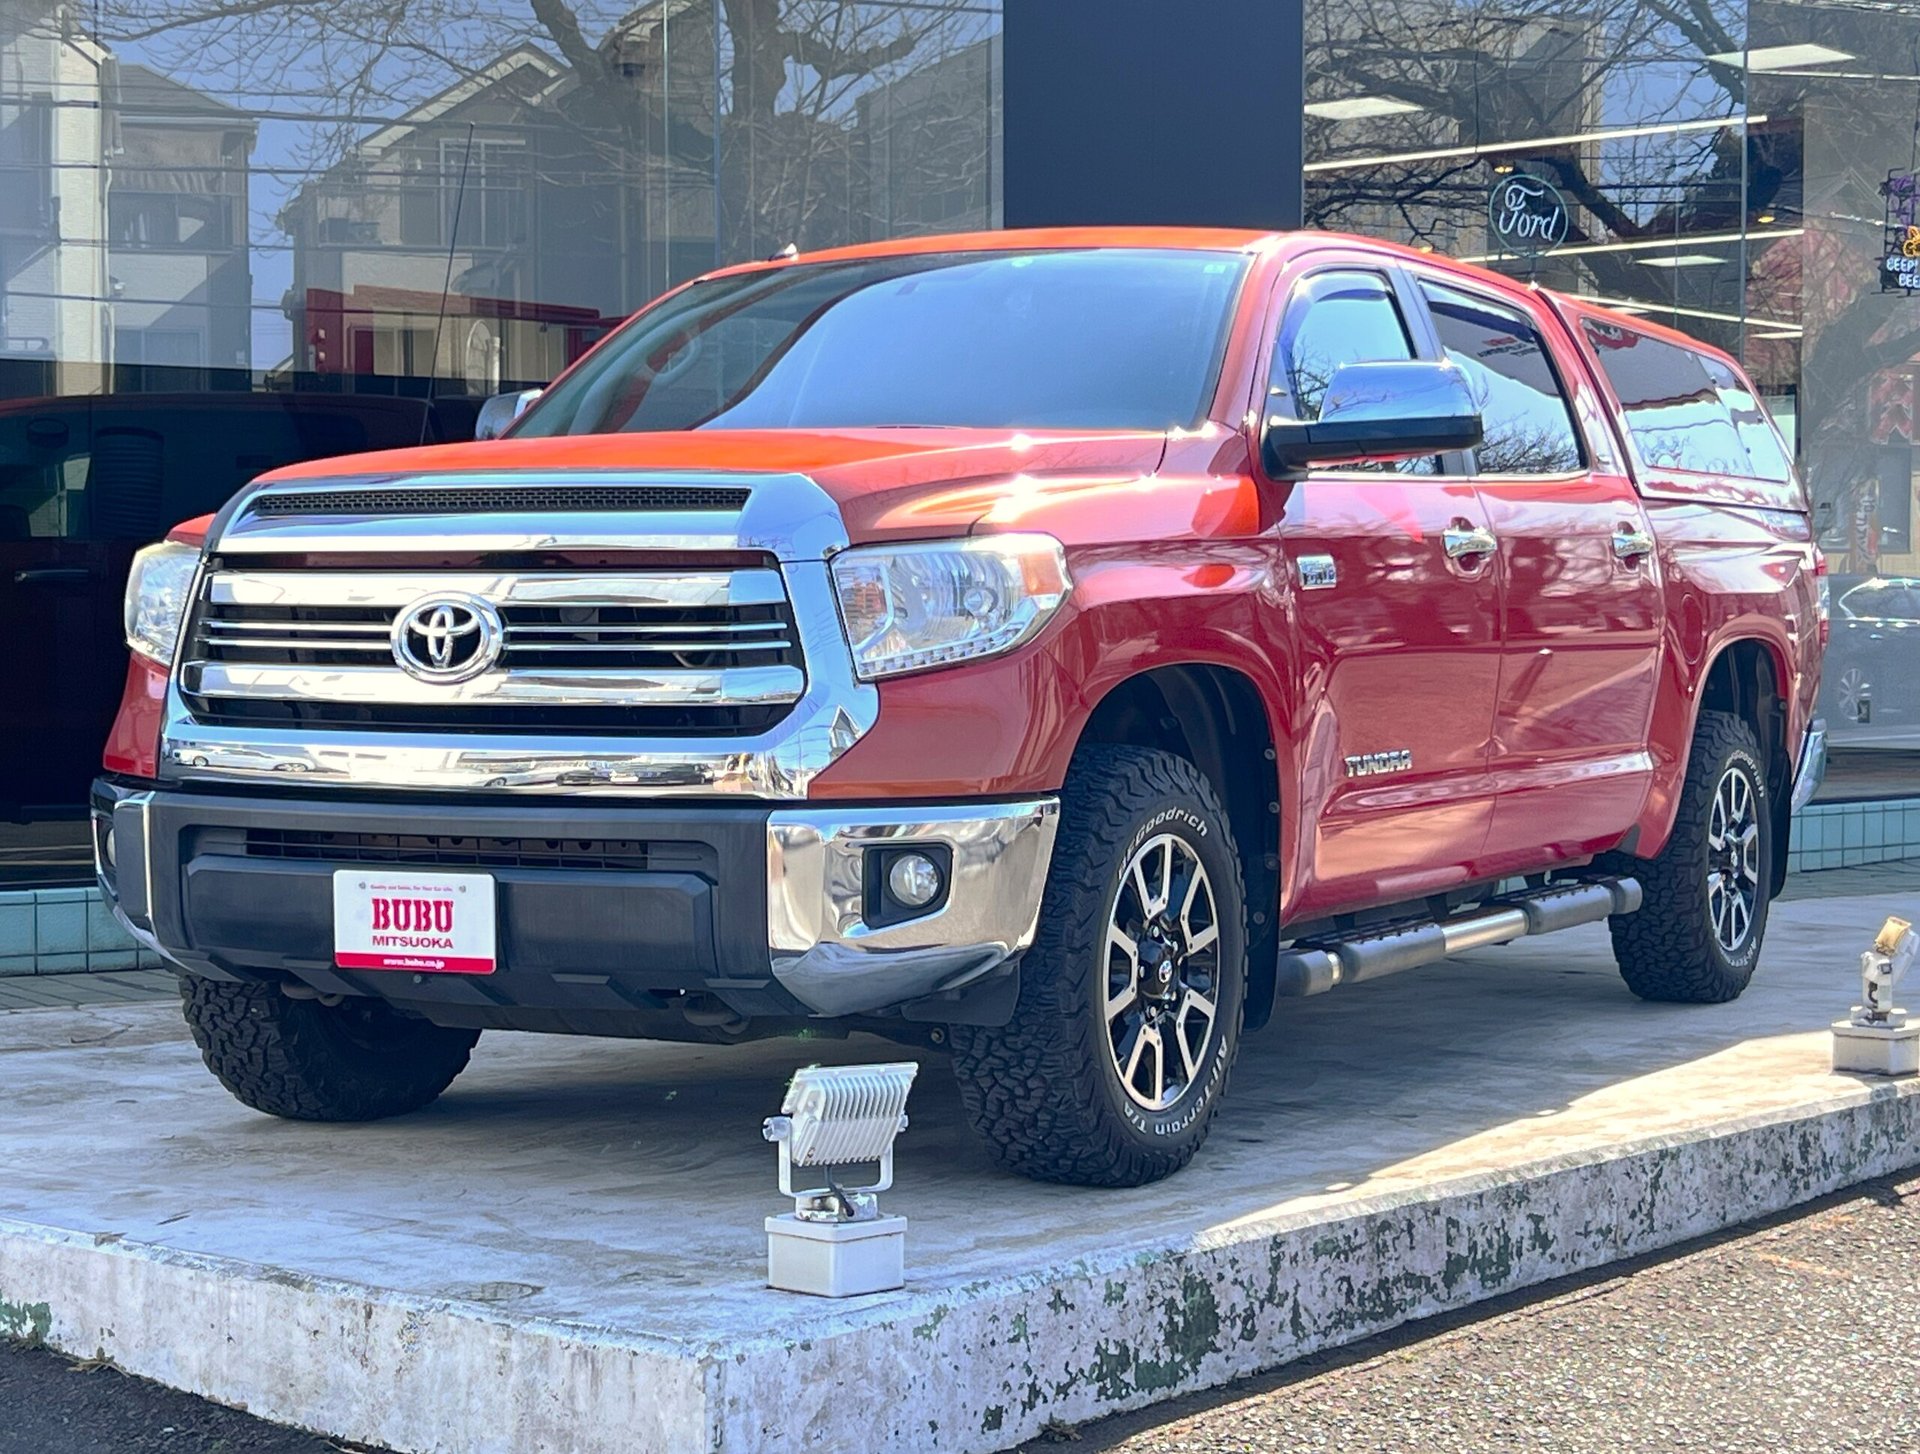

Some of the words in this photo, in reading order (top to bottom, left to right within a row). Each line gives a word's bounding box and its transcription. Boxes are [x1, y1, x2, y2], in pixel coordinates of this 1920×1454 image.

[1499, 184, 1560, 241] Ford
[1344, 749, 1413, 777] TUNDRA
[372, 898, 454, 933] BUBU
[372, 935, 454, 949] MITSUOKA
